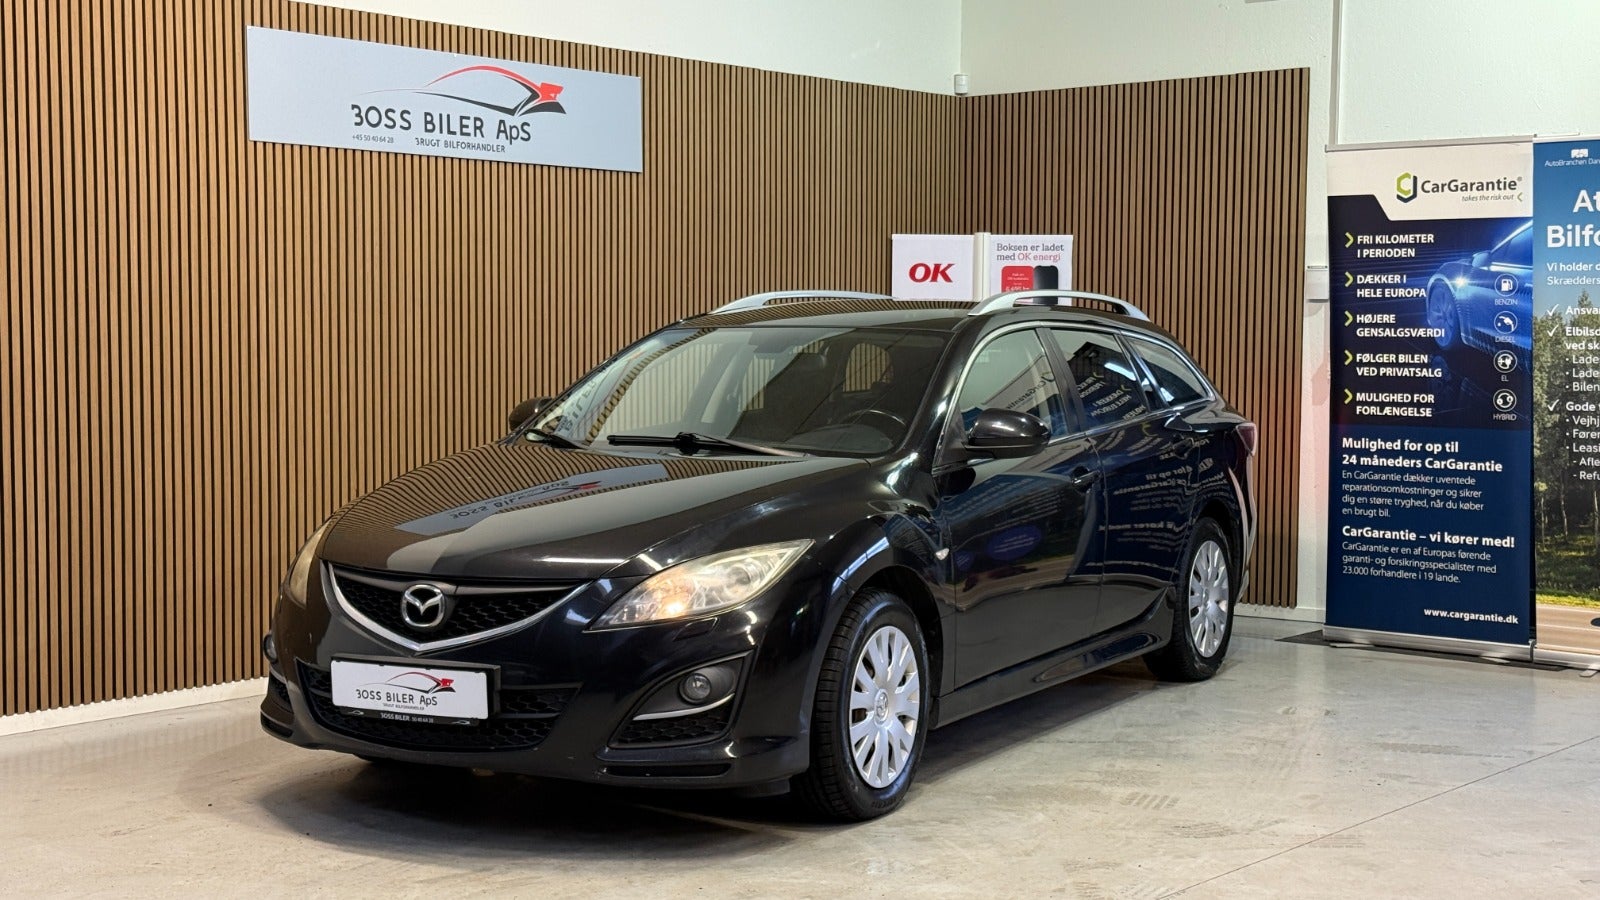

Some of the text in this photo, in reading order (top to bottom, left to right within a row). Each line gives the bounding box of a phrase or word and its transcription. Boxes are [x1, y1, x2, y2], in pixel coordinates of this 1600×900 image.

[424, 112, 484, 138] BILER
[496, 119, 531, 145] ApS
[444, 140, 505, 152] BILFORHANDLER
[1358, 234, 1434, 244] FRI KILOMETER
[997, 243, 1028, 251] Boksen
[1042, 243, 1064, 251] ladet
[1033, 253, 1060, 262] energi
[1358, 249, 1415, 258] I PERIODEN
[1547, 263, 1557, 271] Vi
[1560, 263, 1591, 271] holder
[909, 263, 955, 283] OK
[1357, 275, 1406, 284] DÆKKER I
[1357, 289, 1426, 297] HELE EUROPA
[1357, 314, 1395, 324] HØJERE
[1356, 328, 1445, 337] GENSALGSVÆRDI
[1566, 341, 1585, 350] ved
[1356, 354, 1428, 363] FØLGER BILEN
[1356, 367, 1442, 377] VED PRIVATSALG
[1356, 392, 1434, 403] MULIGHED FOR
[1356, 406, 1432, 416] FORLÆNGELSE
[1566, 402, 1596, 411] Gode
[1342, 438, 1459, 454] Mulighed for op til
[1342, 455, 1502, 472] 24 måneders CarGarantie
[1342, 471, 1476, 485] En CarGarantie dækker uventede
[1342, 484, 1482, 498] reparationsomkostninger og sikrer
[1342, 495, 1356, 505] dig
[1370, 497, 1392, 505] større
[1394, 498, 1428, 509] tryghed,
[1430, 500, 1444, 508] når
[1446, 501, 1457, 509] du
[1460, 502, 1484, 511] køber
[1355, 508, 1377, 518] brugt
[1379, 509, 1390, 517] bil.
[1343, 526, 1416, 541] CarGarantie
[1430, 533, 1441, 542] vi
[1445, 533, 1478, 545] kører
[1482, 536, 1515, 548] med!
[1342, 542, 1389, 553] CarGarantie
[1401, 546, 1411, 554] en
[1413, 547, 1421, 555] af
[1423, 548, 1456, 559] Europas
[1458, 551, 1491, 560] førende
[1343, 555, 1496, 574] garanti- og forsikringsspecialister med
[1343, 566, 1368, 575] 23.000
[1370, 568, 1416, 580] forhandlere
[1424, 572, 1433, 580] 19
[1435, 573, 1460, 583] lande.
[1424, 609, 1518, 624] www.cargarantie.dk
[386, 692, 414, 704] BILER
[420, 695, 437, 707] ApS
